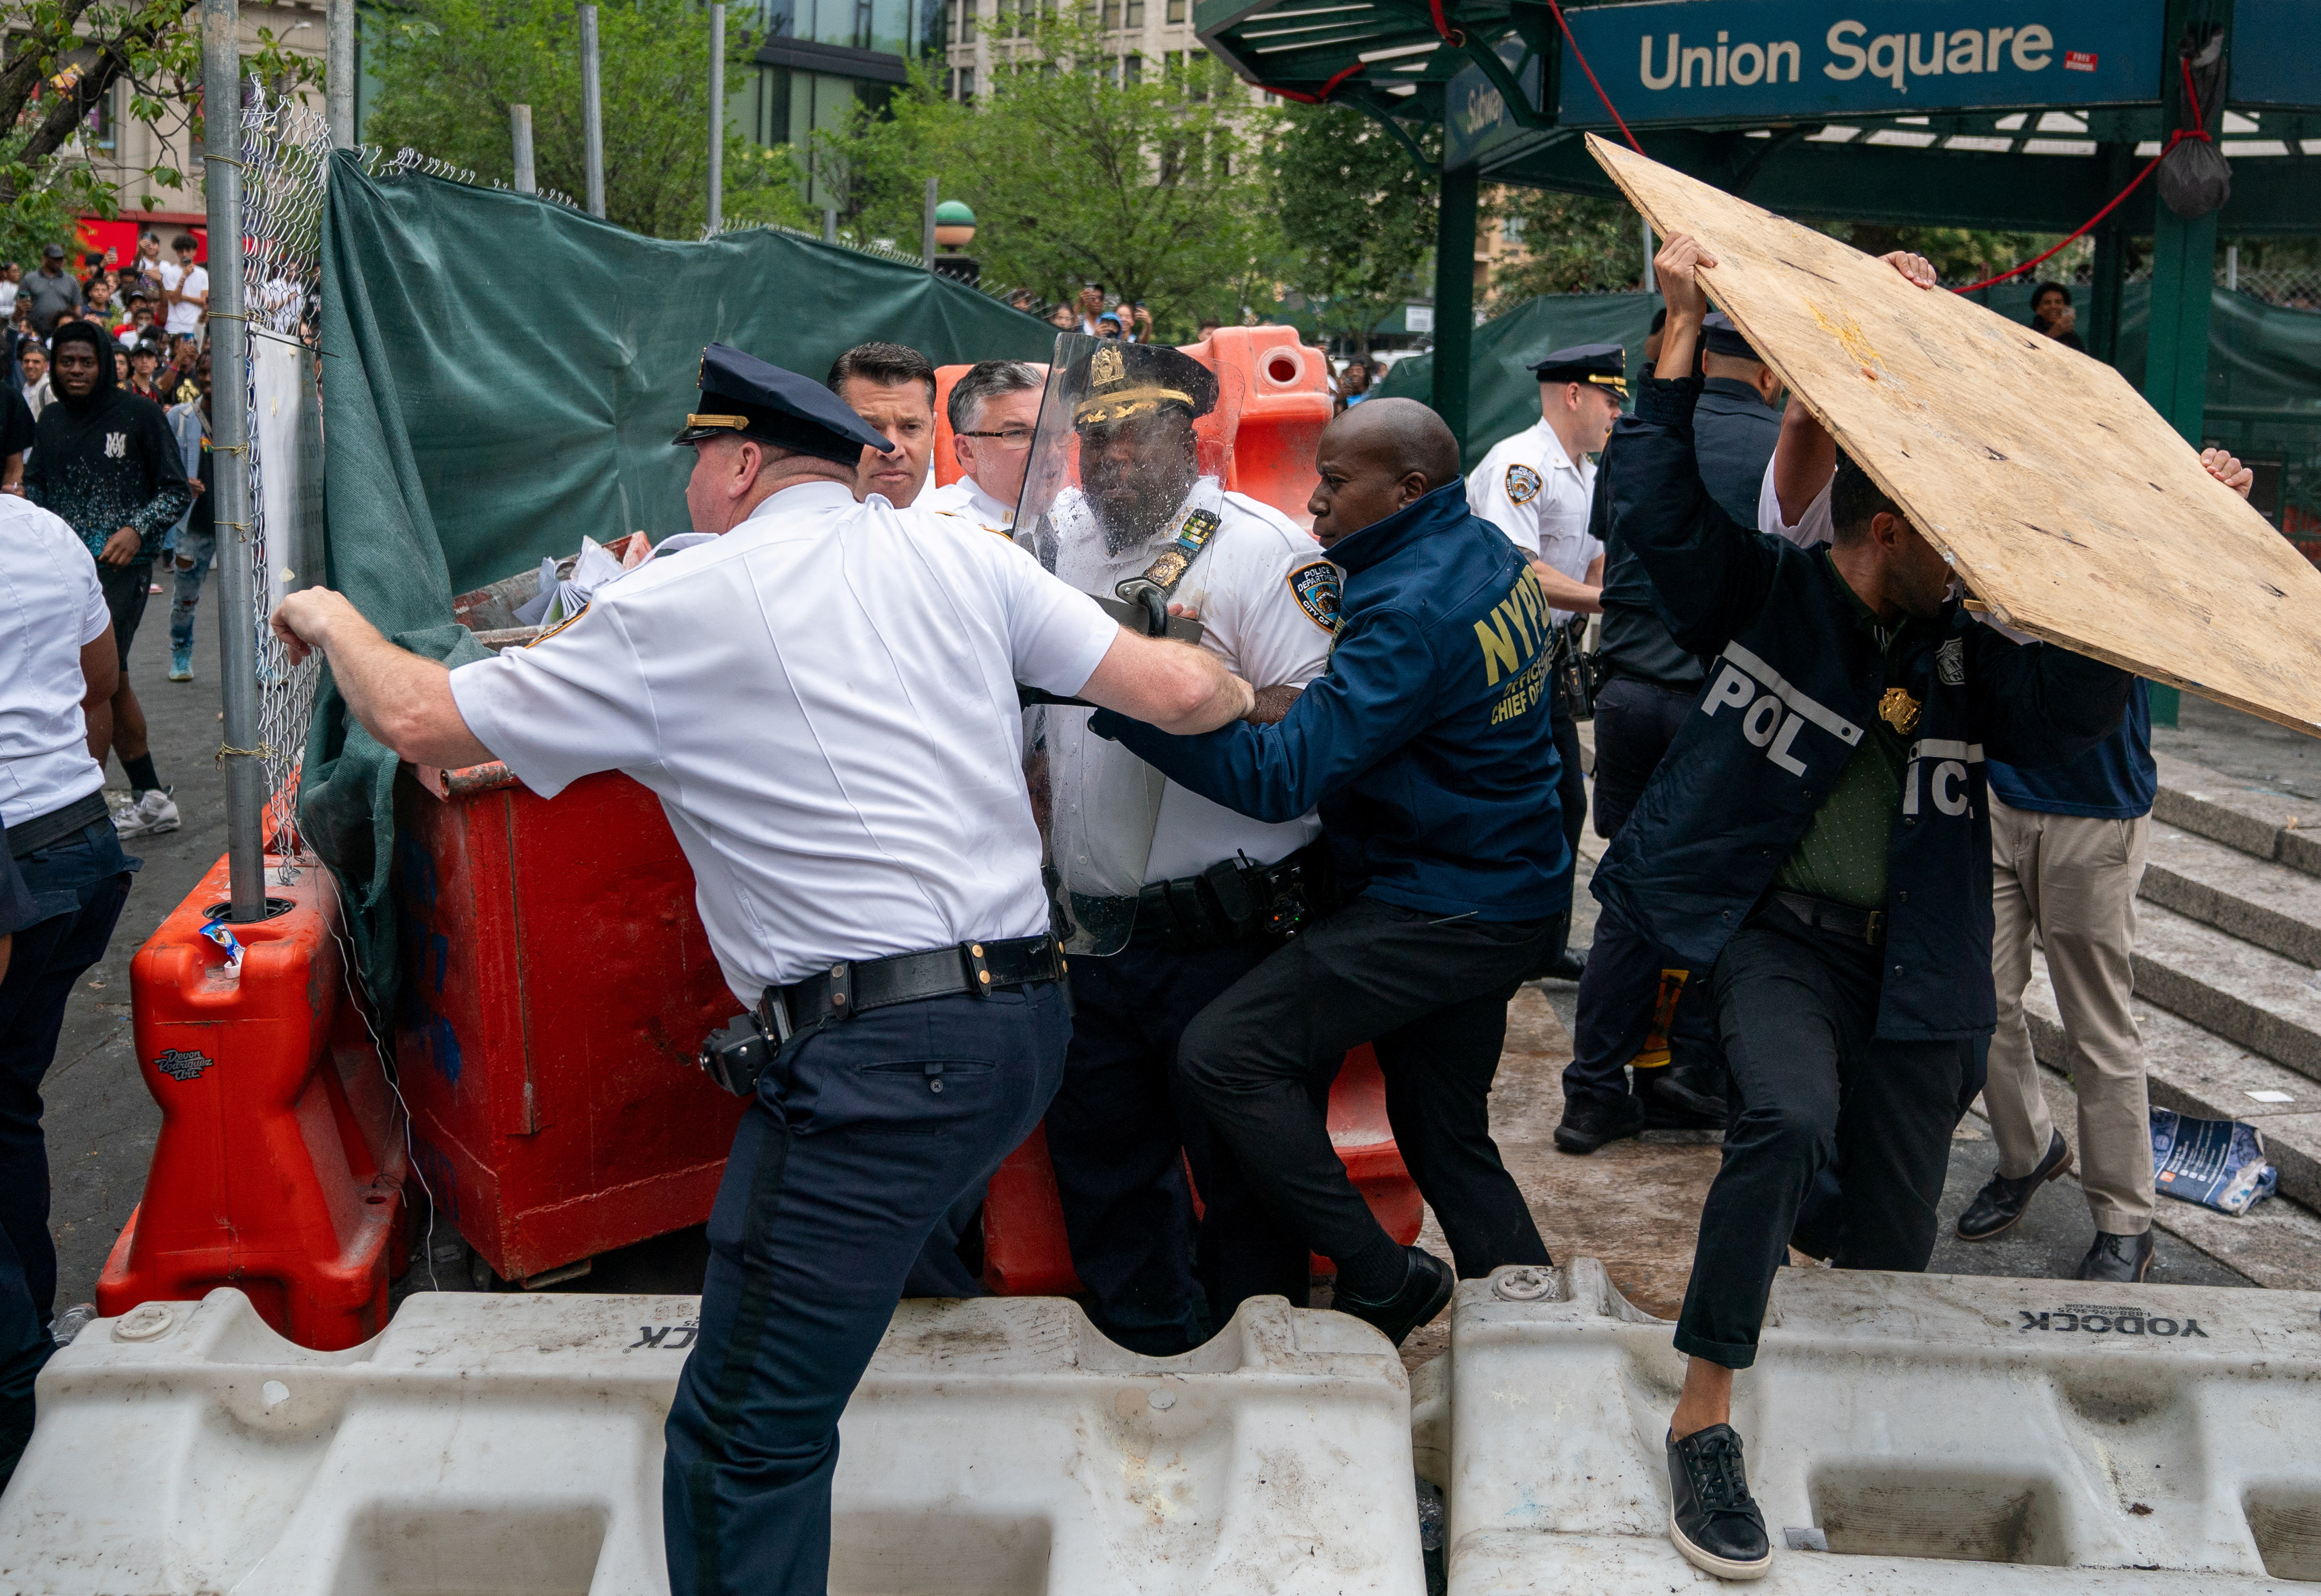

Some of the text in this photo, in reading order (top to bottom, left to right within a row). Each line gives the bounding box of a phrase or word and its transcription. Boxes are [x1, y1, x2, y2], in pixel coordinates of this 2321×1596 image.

[1640, 19, 2054, 91] Union Square
[1297, 574, 1338, 592] DEPARTMENT
[1304, 567, 1331, 579] POLICE
[1303, 600, 1330, 625] CITY OF
[1474, 564, 1552, 687] NYPD
[1502, 657, 1541, 697] OFFICE
[1491, 680, 1540, 725] CHIEF OF
[1903, 761, 1973, 818] IC
[161, 1049, 202, 1063] Devon
[2019, 1311, 2210, 1338] YODOCK
